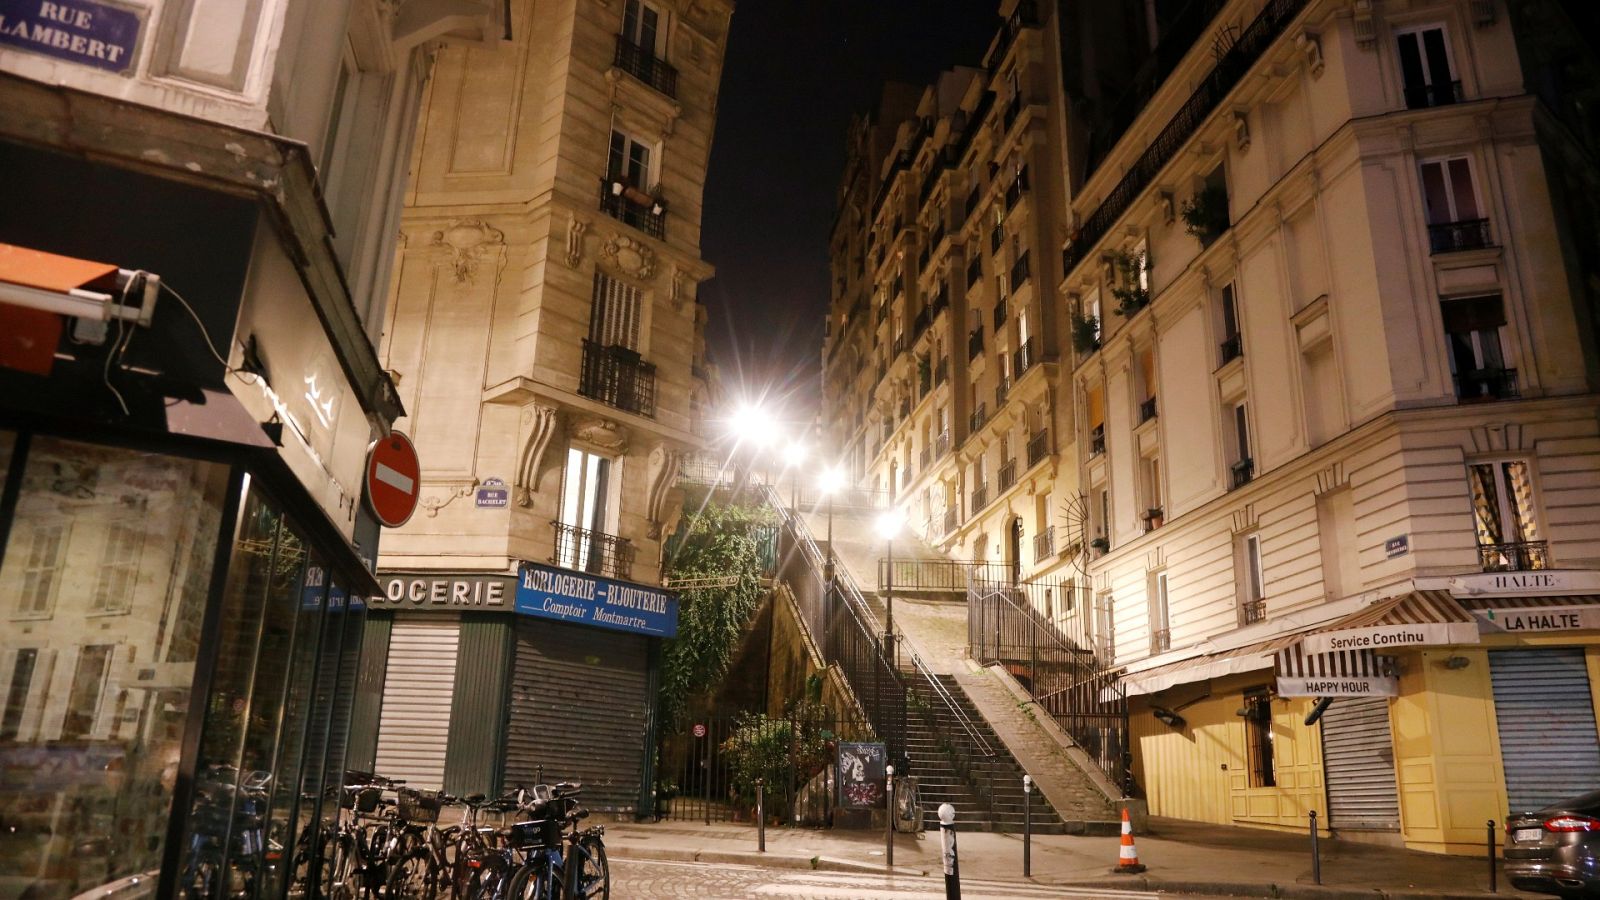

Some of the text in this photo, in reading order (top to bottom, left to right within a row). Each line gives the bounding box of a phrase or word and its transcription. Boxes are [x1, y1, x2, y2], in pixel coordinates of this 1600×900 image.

[40, 1, 93, 30] RUE
[0, 15, 124, 63] LAMBERT
[1496, 574, 1555, 588] HALTE
[543, 597, 646, 630] Comptoir Montmartre
[1505, 614, 1580, 630] LA HALTE
[1331, 631, 1425, 649] Service Continu
[1306, 682, 1370, 693] HAPPY HOUR
